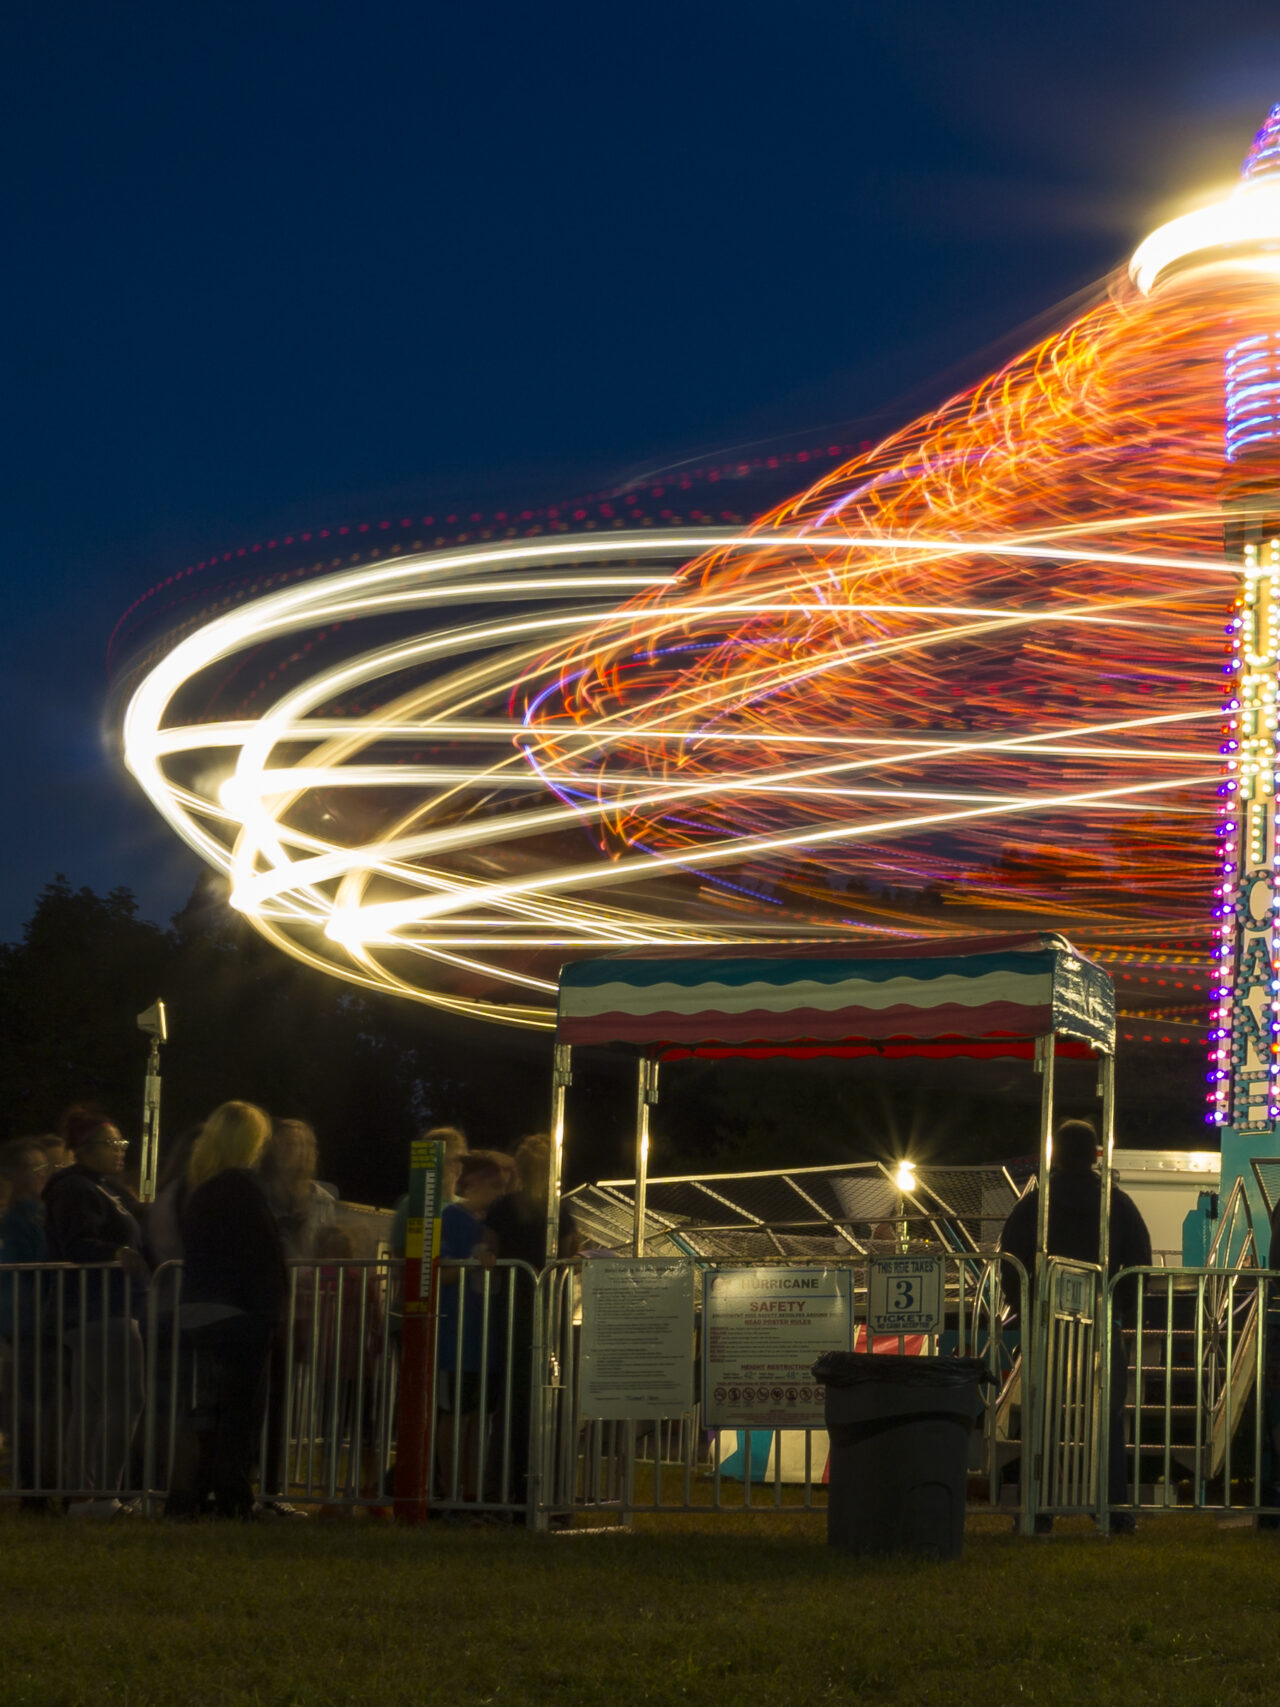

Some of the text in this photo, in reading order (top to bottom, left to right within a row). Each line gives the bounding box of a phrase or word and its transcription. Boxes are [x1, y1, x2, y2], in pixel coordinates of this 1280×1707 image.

[877, 1262, 892, 1273] THIS
[911, 1261, 934, 1272] TAKES
[741, 1278, 819, 1290] HURRICANE
[894, 1280, 914, 1309] 3
[750, 1301, 806, 1312] SAFETY
[875, 1314, 933, 1322] TICKETS
